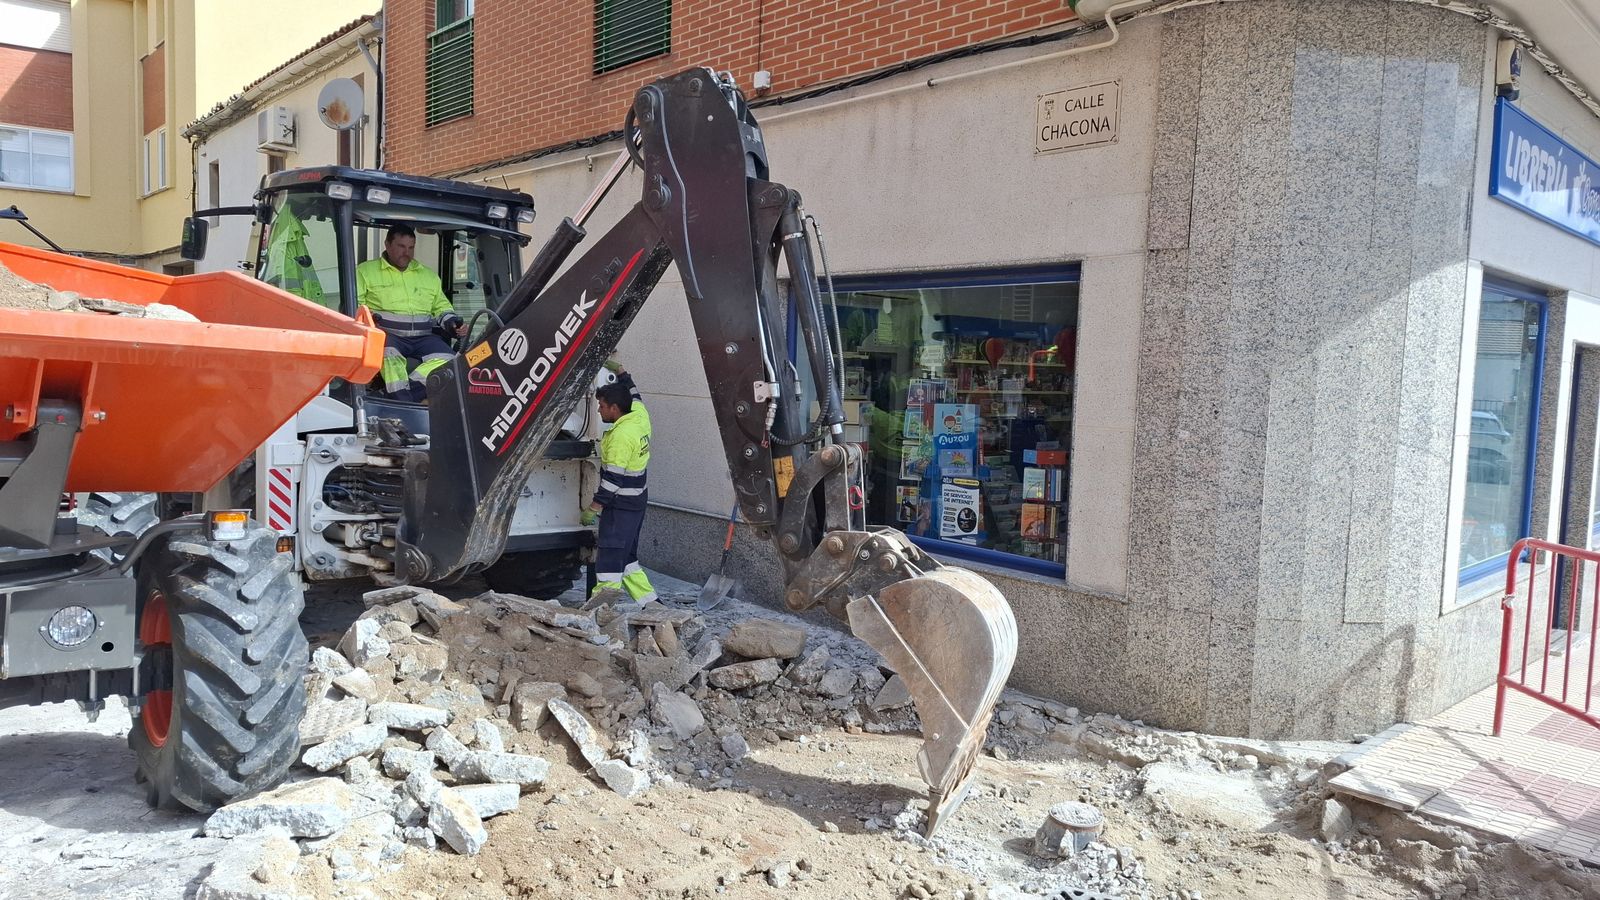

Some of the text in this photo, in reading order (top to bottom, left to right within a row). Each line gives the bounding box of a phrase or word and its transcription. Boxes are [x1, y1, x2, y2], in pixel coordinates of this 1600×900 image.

[1064, 93, 1105, 113] CALLE
[1041, 116, 1111, 142] CHACONA
[1505, 130, 1569, 211] LIBRERÍA
[500, 330, 525, 361] 40
[939, 434, 969, 446] AUZOU
[951, 498, 974, 506] INTERNET
